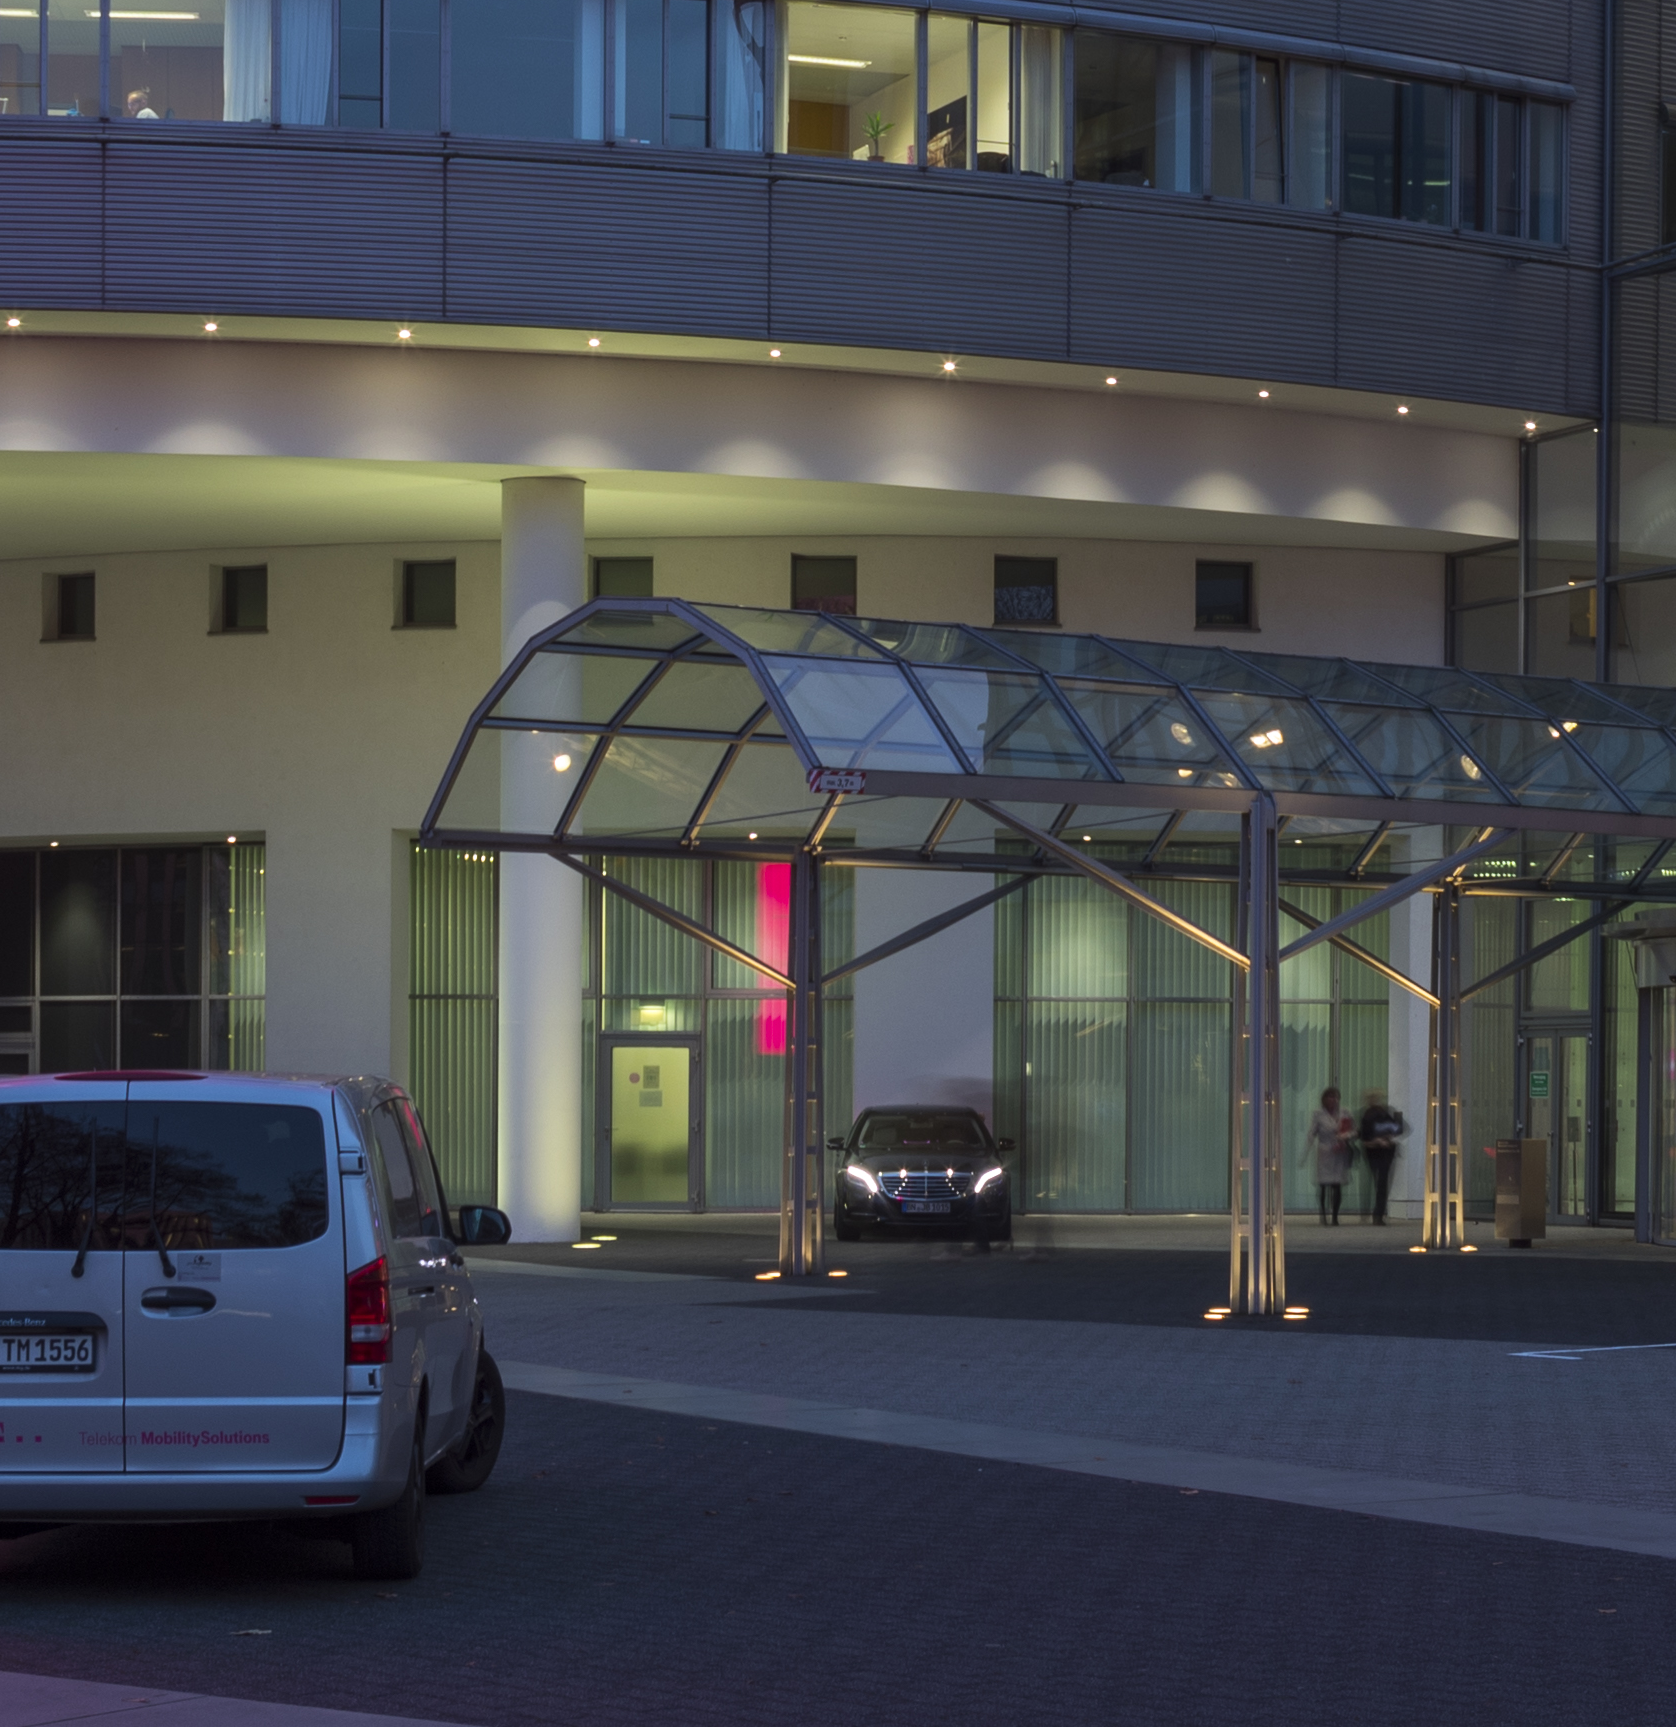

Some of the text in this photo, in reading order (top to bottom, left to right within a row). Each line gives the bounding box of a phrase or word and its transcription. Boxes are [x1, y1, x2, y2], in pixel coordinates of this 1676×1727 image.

[836, 777, 850, 788] 3,7
[2, 1338, 31, 1362] TM
[34, 1338, 90, 1362] 1556
[78, 1430, 270, 1448] Telekom MobilitySolutions
